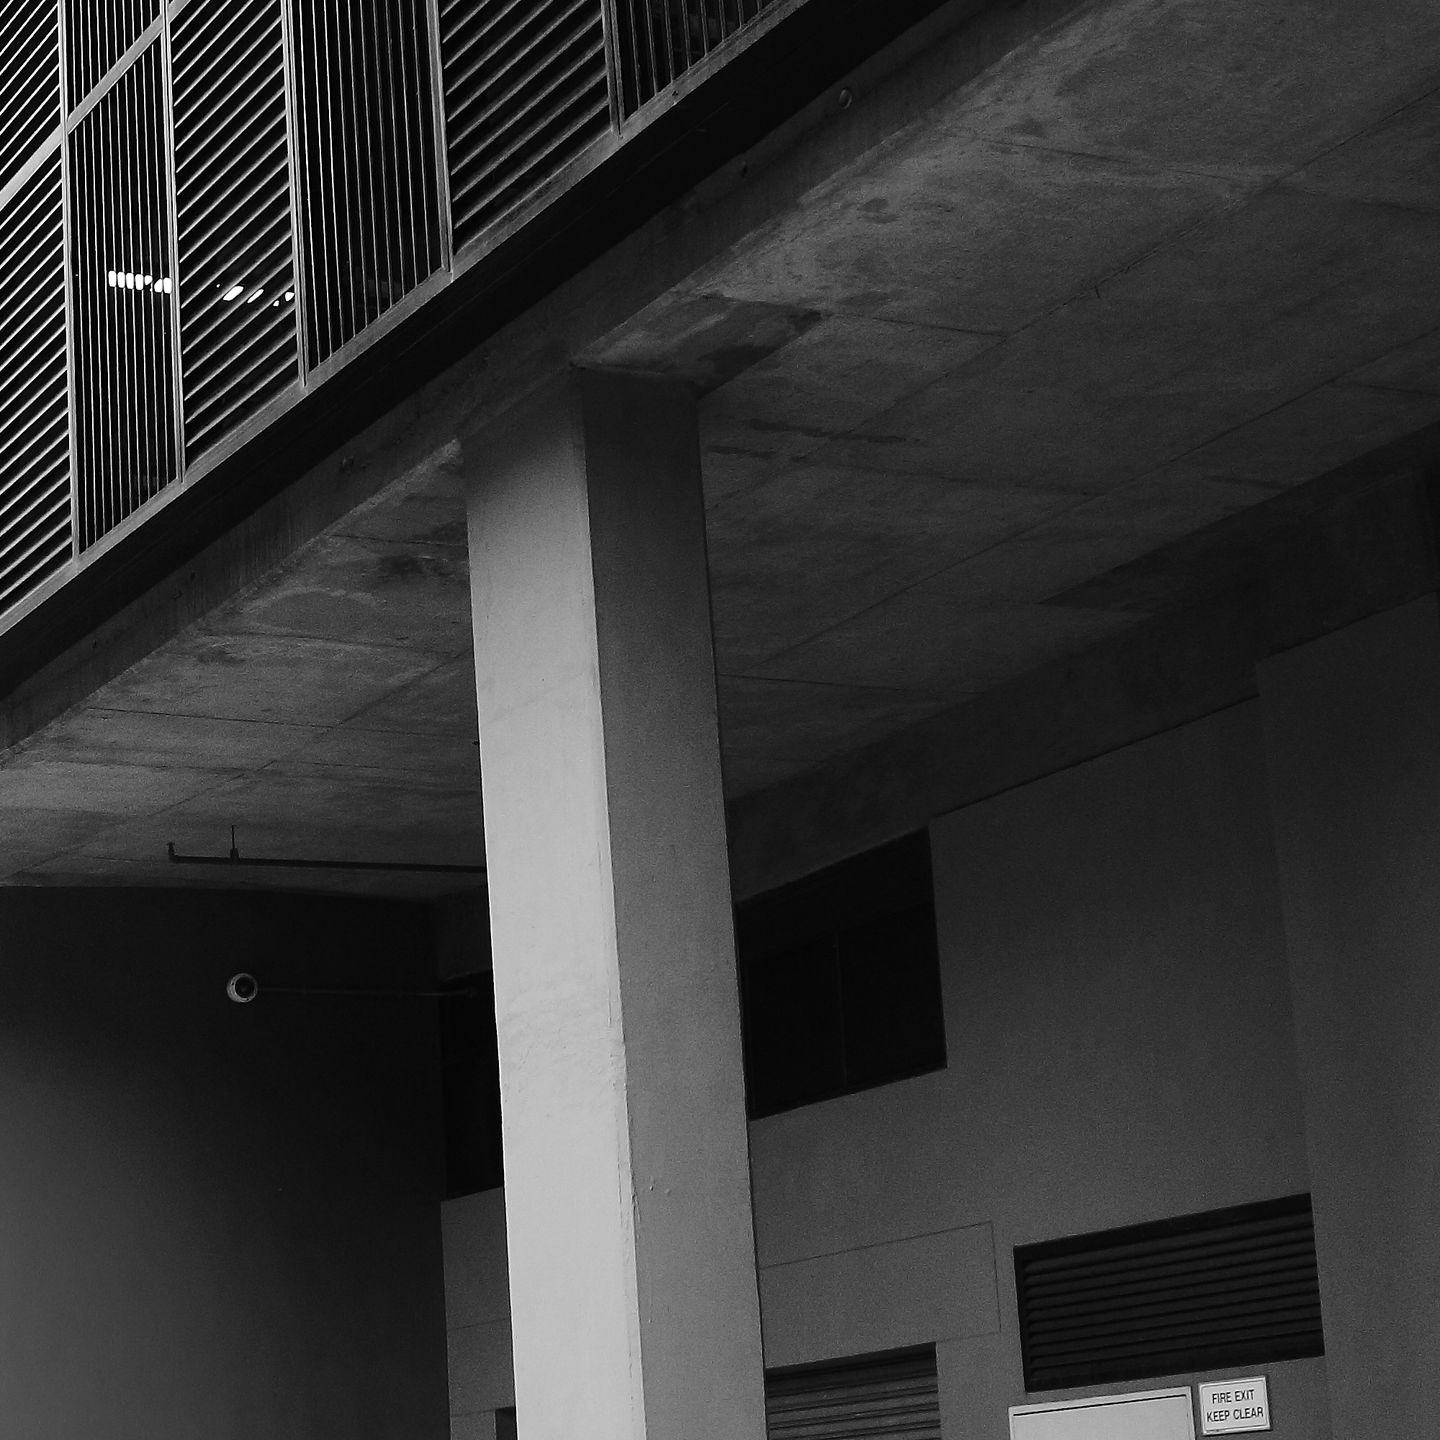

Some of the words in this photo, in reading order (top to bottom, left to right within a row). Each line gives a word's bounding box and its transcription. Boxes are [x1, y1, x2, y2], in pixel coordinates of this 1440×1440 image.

[1212, 1392, 1232, 1404] FIRE
[1235, 1389, 1254, 1401] EXIT
[1207, 1410, 1229, 1422] KEEP
[1233, 1407, 1263, 1419] CLEAR
